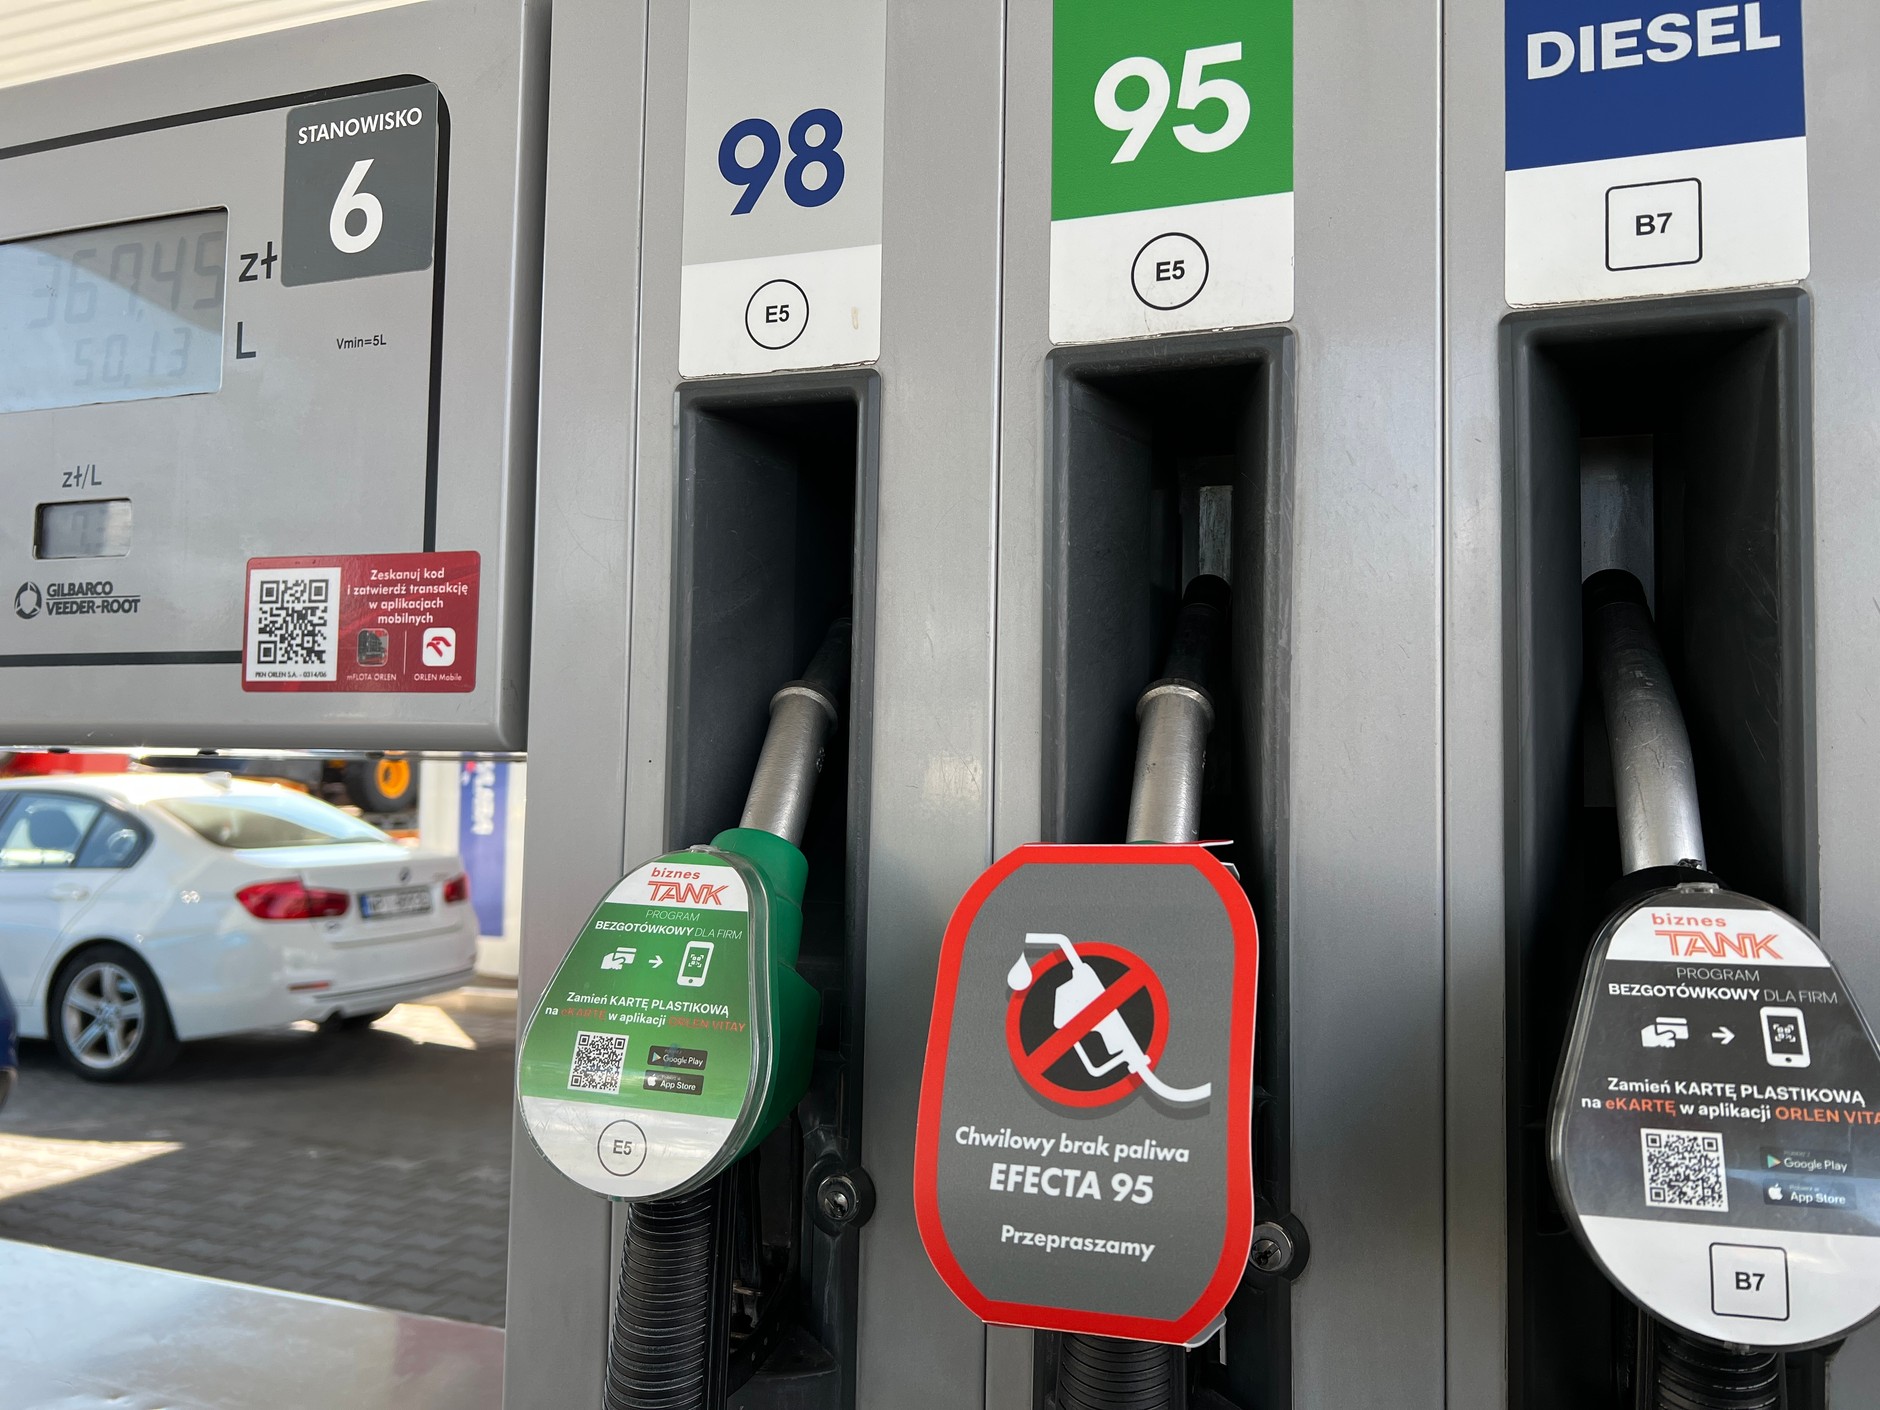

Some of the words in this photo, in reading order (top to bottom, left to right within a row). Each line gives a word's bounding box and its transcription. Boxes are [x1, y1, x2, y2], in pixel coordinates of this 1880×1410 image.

[1527, 1, 1781, 80] DIESEL
[1093, 41, 1251, 164] 95
[297, 107, 424, 145] STANOWISKO
[718, 108, 845, 216] 98
[329, 158, 384, 254] 6
[1636, 212, 1673, 236] B7
[238, 241, 278, 282] zł
[1156, 260, 1185, 282] E5
[765, 304, 790, 323] E5
[236, 321, 257, 360] L
[336, 335, 387, 350] Vmin=5L
[61, 464, 102, 490] zł/L
[370, 569, 420, 581] Zeskanuj
[424, 568, 445, 579] kod
[46, 581, 113, 597] GILBARCO
[347, 585, 351, 596] i
[353, 583, 406, 595] zatwierdź
[409, 582, 469, 595] transakcję
[46, 598, 141, 615] VEEDER-ROOT
[369, 601, 378, 610] w
[381, 598, 444, 611] aplikacjach
[378, 613, 433, 626] mobilnych
[373, 673, 397, 681] ORLEN
[414, 673, 437, 681] ORLEN
[438, 673, 462, 681] Mobile
[651, 867, 701, 880] biznes
[648, 880, 729, 905] TANK
[646, 910, 700, 922] PROGRAM
[1651, 913, 1727, 928] biznes
[595, 920, 694, 937] BEZGOTÓWKOWY
[694, 927, 715, 938] DLA
[716, 929, 743, 940] FIRM
[1654, 930, 1783, 960] TANK
[1676, 966, 1760, 982] PROGRAM
[1608, 983, 1760, 1001] BEZGOTÓWKOWY
[1764, 990, 1797, 1003] DLA
[1800, 990, 1838, 1004] FIRM
[567, 992, 608, 1004] Zamień
[609, 995, 650, 1011] KARTĘ
[650, 999, 730, 1018] PLASTIKOWĄ
[545, 1006, 559, 1016] na
[608, 1013, 618, 1022] w
[619, 1012, 666, 1028] aplikacji
[668, 1016, 709, 1029] ORLEN
[712, 1019, 746, 1032] VITAY
[662, 1054, 687, 1066] Google
[688, 1056, 703, 1067] Play
[660, 1080, 675, 1089] App
[676, 1081, 696, 1090] Store
[1607, 1077, 1671, 1094] Zamień
[1675, 1081, 1737, 1100] KARTĘ
[1740, 1084, 1866, 1108] PLASTIKOWĄ
[1581, 1097, 1601, 1109] na
[1605, 1097, 1677, 1117] eKARTĘ
[1680, 1104, 1695, 1115] w
[1698, 1102, 1772, 1123] aplikacji
[1775, 1106, 1840, 1123] ORLEN
[613, 1139, 632, 1156] E5
[955, 1126, 1055, 1157] Chwilowy
[1059, 1133, 1109, 1157] brak
[1113, 1139, 1190, 1163] paliwa
[1784, 1157, 1822, 1172] Google
[1824, 1159, 1848, 1173] Play
[989, 1162, 1102, 1200] EFECTA
[1110, 1173, 1154, 1205] 95
[1790, 1191, 1813, 1204] App
[1815, 1192, 1846, 1205] Store
[1000, 1224, 1155, 1262] Przepraszamy
[1734, 1271, 1766, 1292] B7
